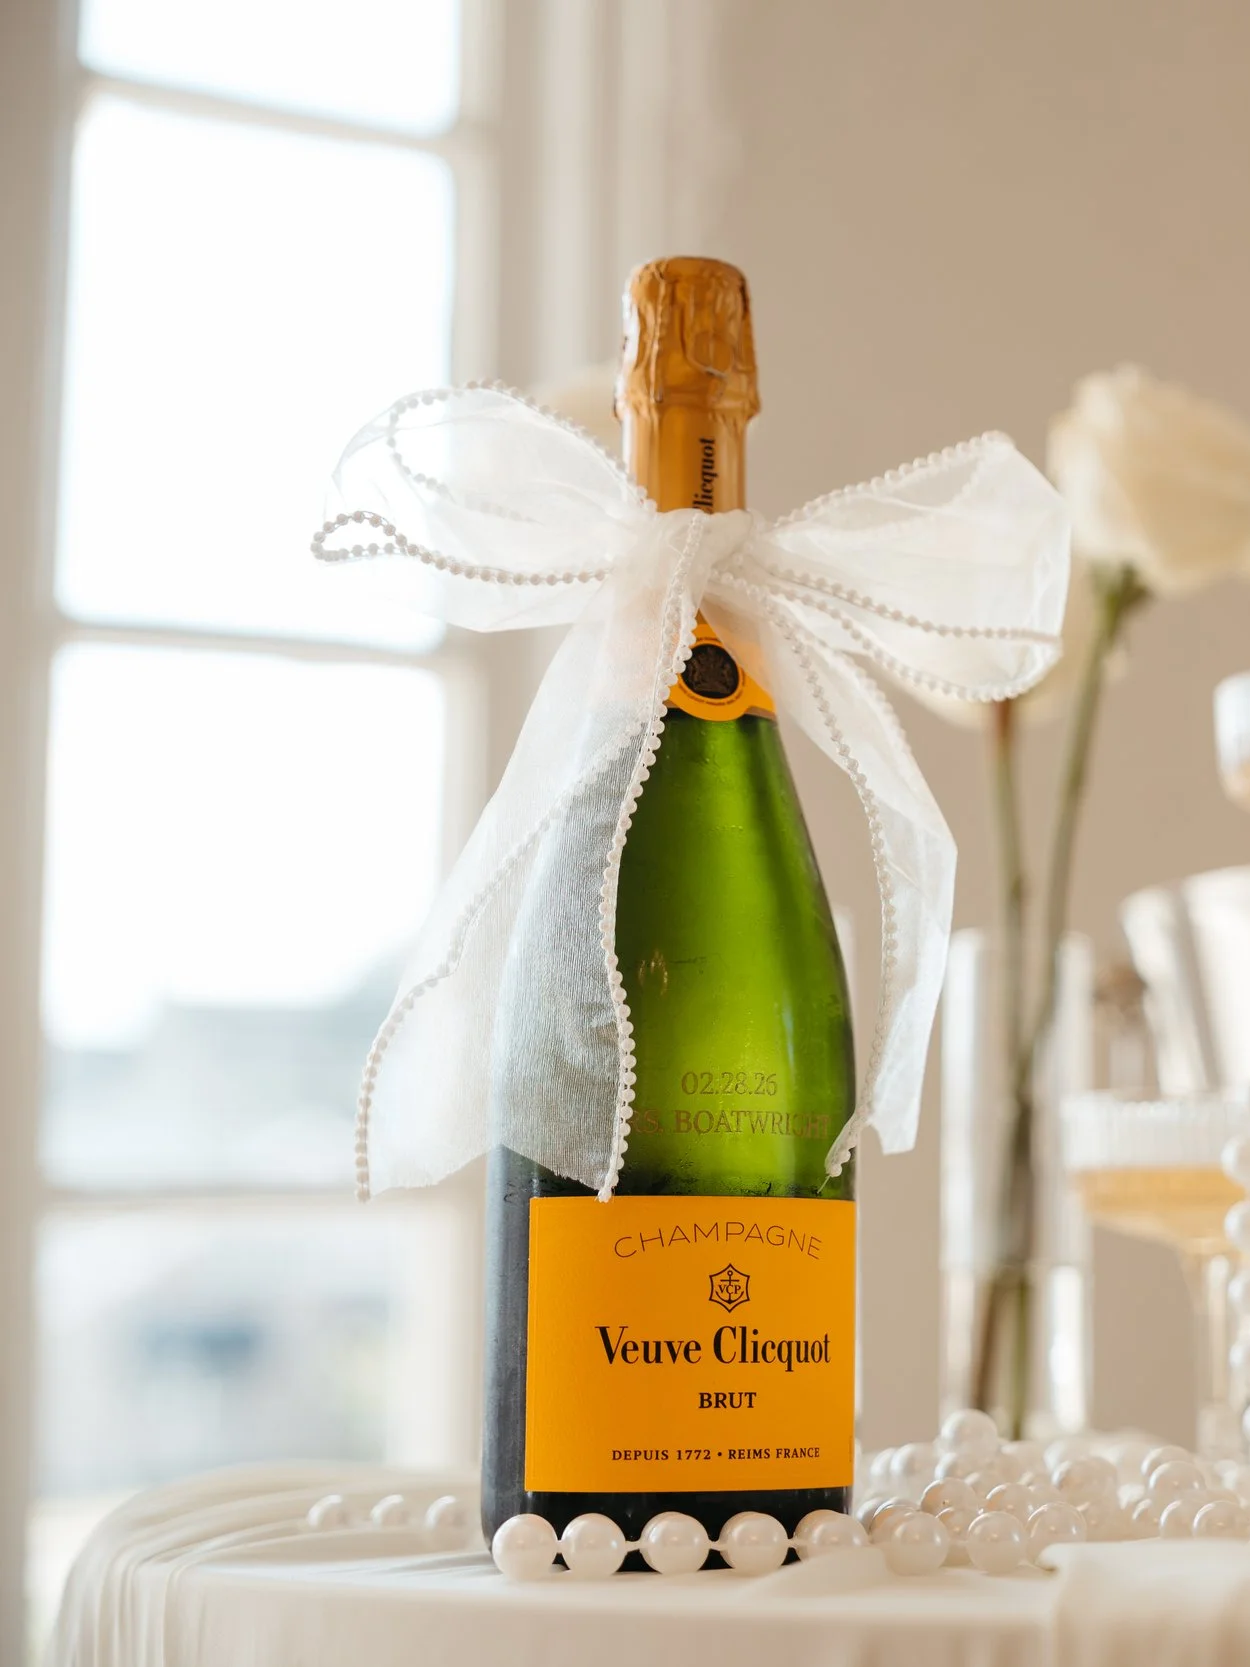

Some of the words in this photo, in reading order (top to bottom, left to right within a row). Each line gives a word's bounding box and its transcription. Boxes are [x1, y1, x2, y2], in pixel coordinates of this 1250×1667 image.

[681, 1071, 778, 1096] 02.28.26
[673, 1109, 831, 1139] BOATWRIGHT
[613, 1221, 823, 1260] CHAMPAGNE
[718, 1284, 742, 1295] VCP
[594, 1325, 702, 1365] Veuve
[712, 1325, 831, 1373] Clicquot
[698, 1391, 757, 1410] BRUT
[611, 1449, 669, 1461] DEPUIS
[676, 1449, 711, 1460] 1772
[727, 1448, 771, 1460] REIMS
[776, 1447, 820, 1459] FRANCE
